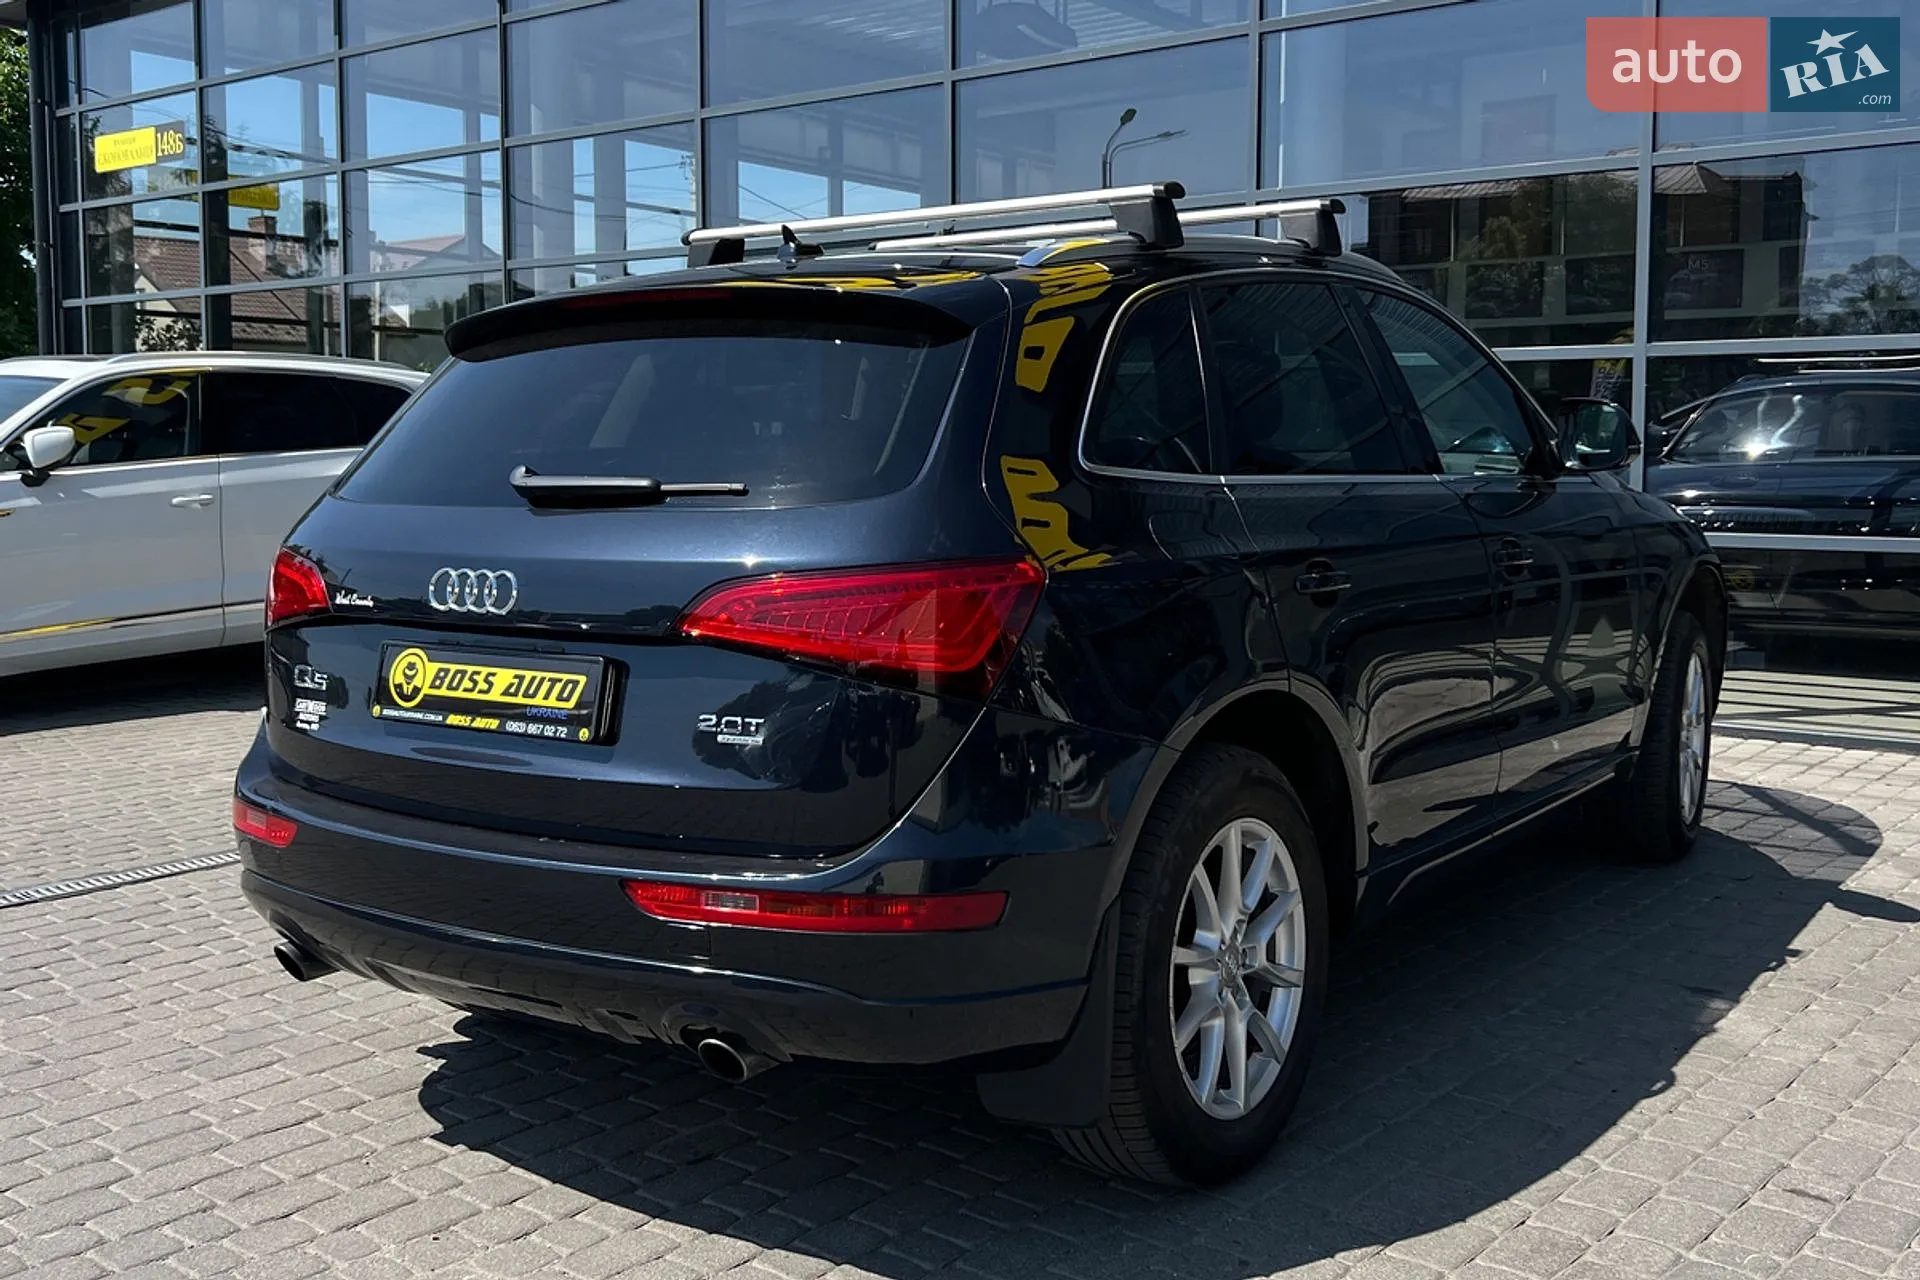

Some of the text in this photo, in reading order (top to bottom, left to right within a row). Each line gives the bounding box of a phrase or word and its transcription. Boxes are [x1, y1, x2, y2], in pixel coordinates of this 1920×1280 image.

[294, 664, 328, 691] Q5
[429, 667, 580, 702] BOSS AUTO
[446, 714, 500, 730] BOSS AUTO
[527, 706, 568, 720] UKRAINE
[697, 713, 765, 736] 2.0T
